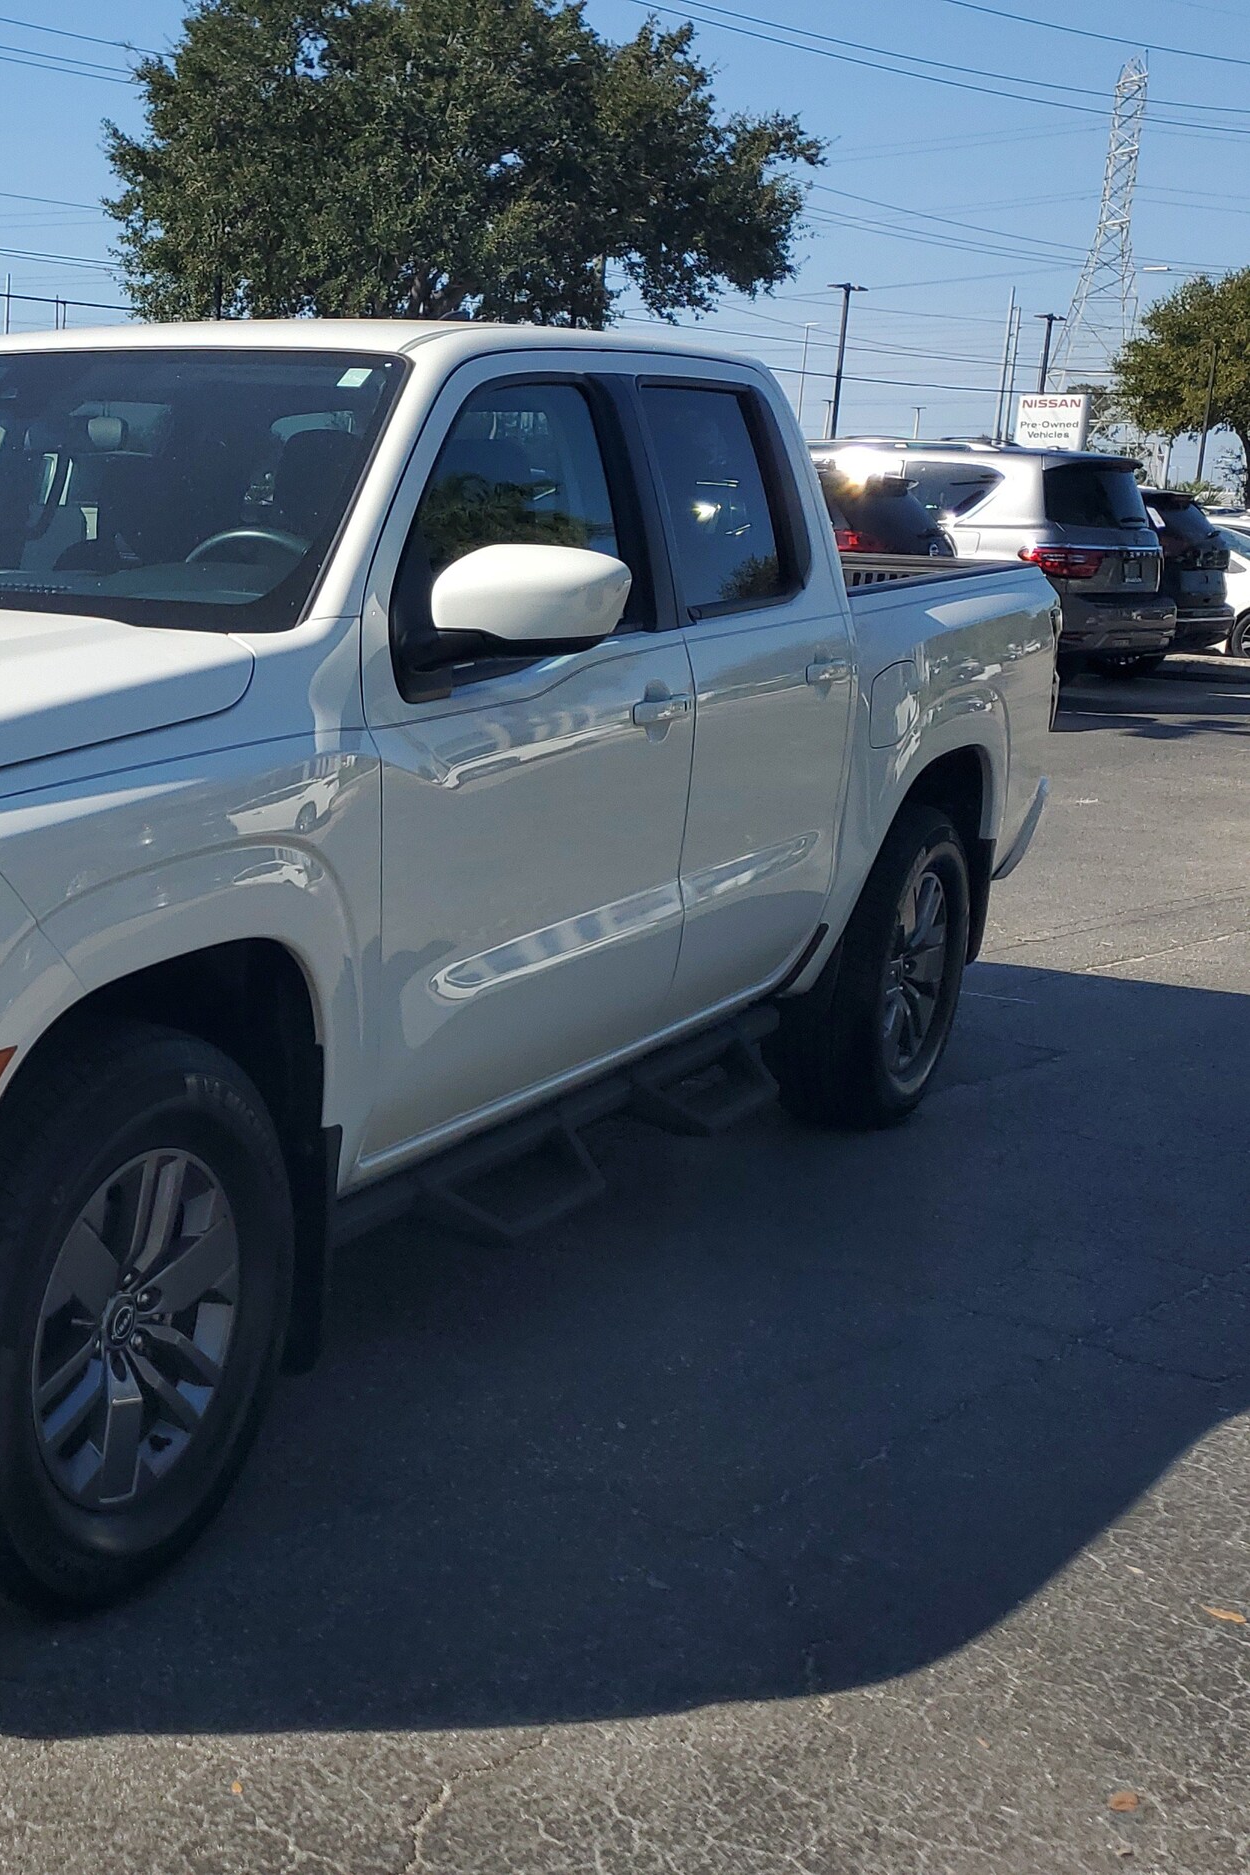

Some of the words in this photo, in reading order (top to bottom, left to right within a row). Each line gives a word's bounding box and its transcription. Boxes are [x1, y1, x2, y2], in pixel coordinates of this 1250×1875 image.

[1022, 399, 1081, 409] NISSAN
[1020, 420, 1079, 429] Pre-Owned
[1027, 431, 1070, 439] Vehicles
